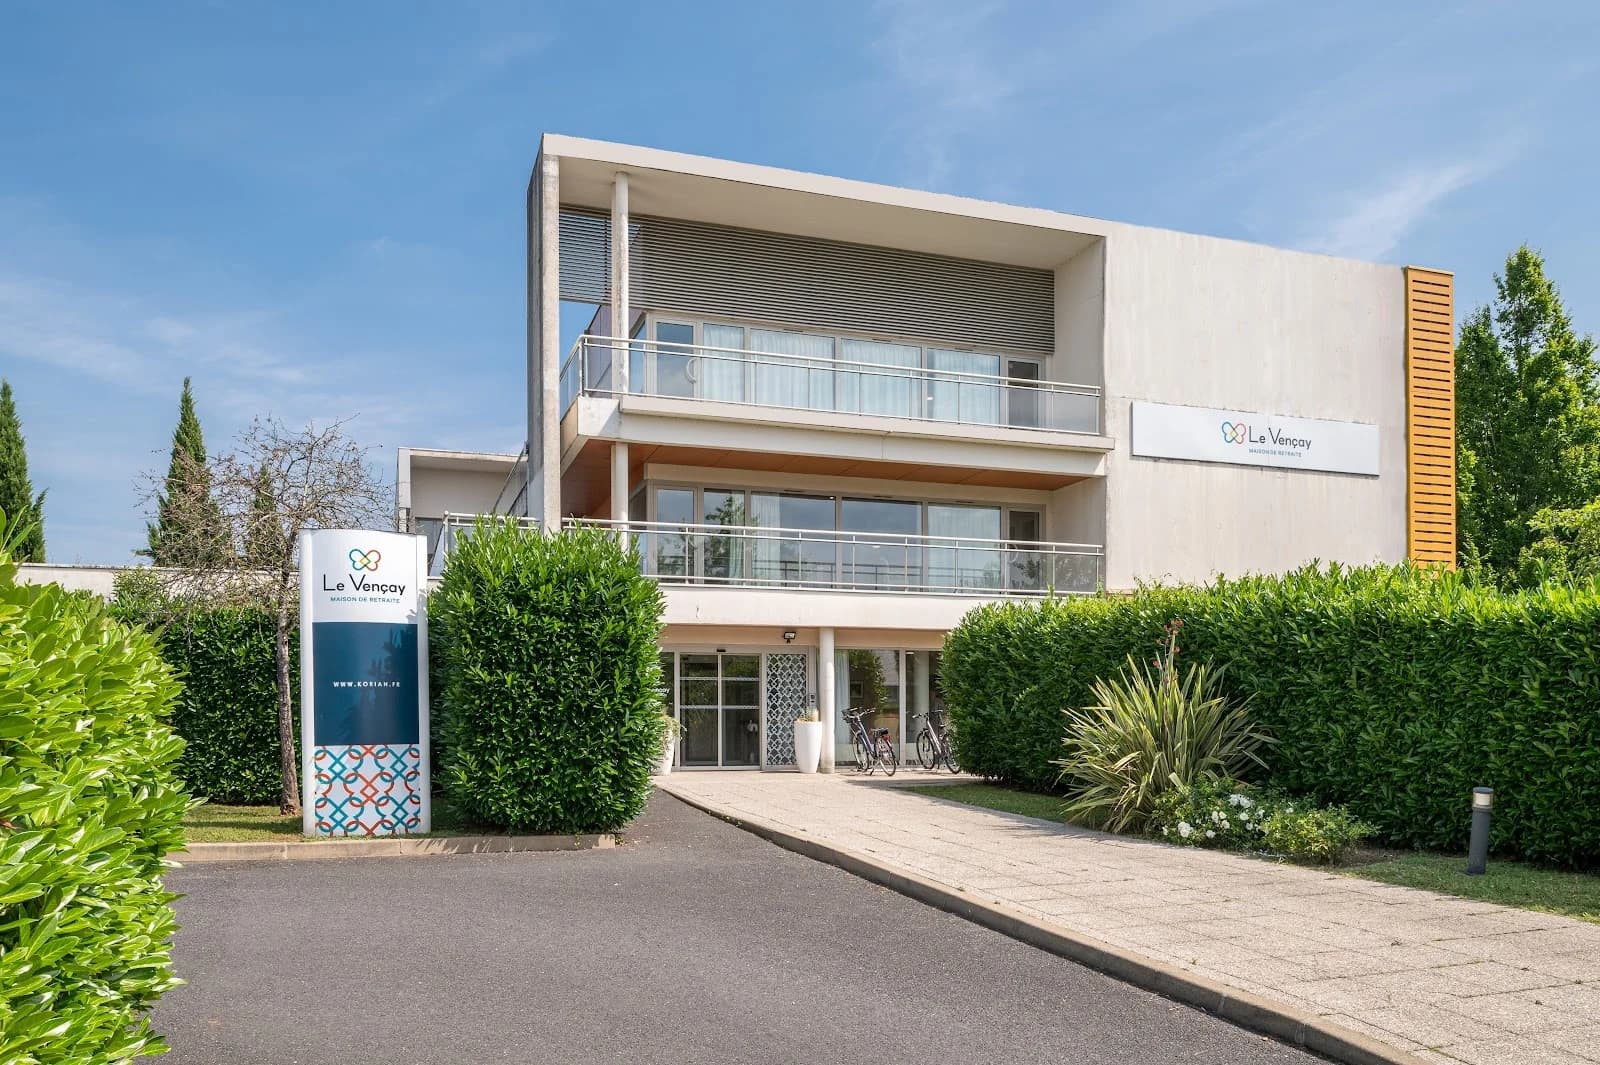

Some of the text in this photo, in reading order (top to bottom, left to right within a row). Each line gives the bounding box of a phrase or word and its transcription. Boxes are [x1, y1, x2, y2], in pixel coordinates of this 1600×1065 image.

[1249, 426, 1312, 450] Le Vençay
[1278, 450, 1302, 458] RETRAITE
[323, 574, 406, 596] Le Vençay
